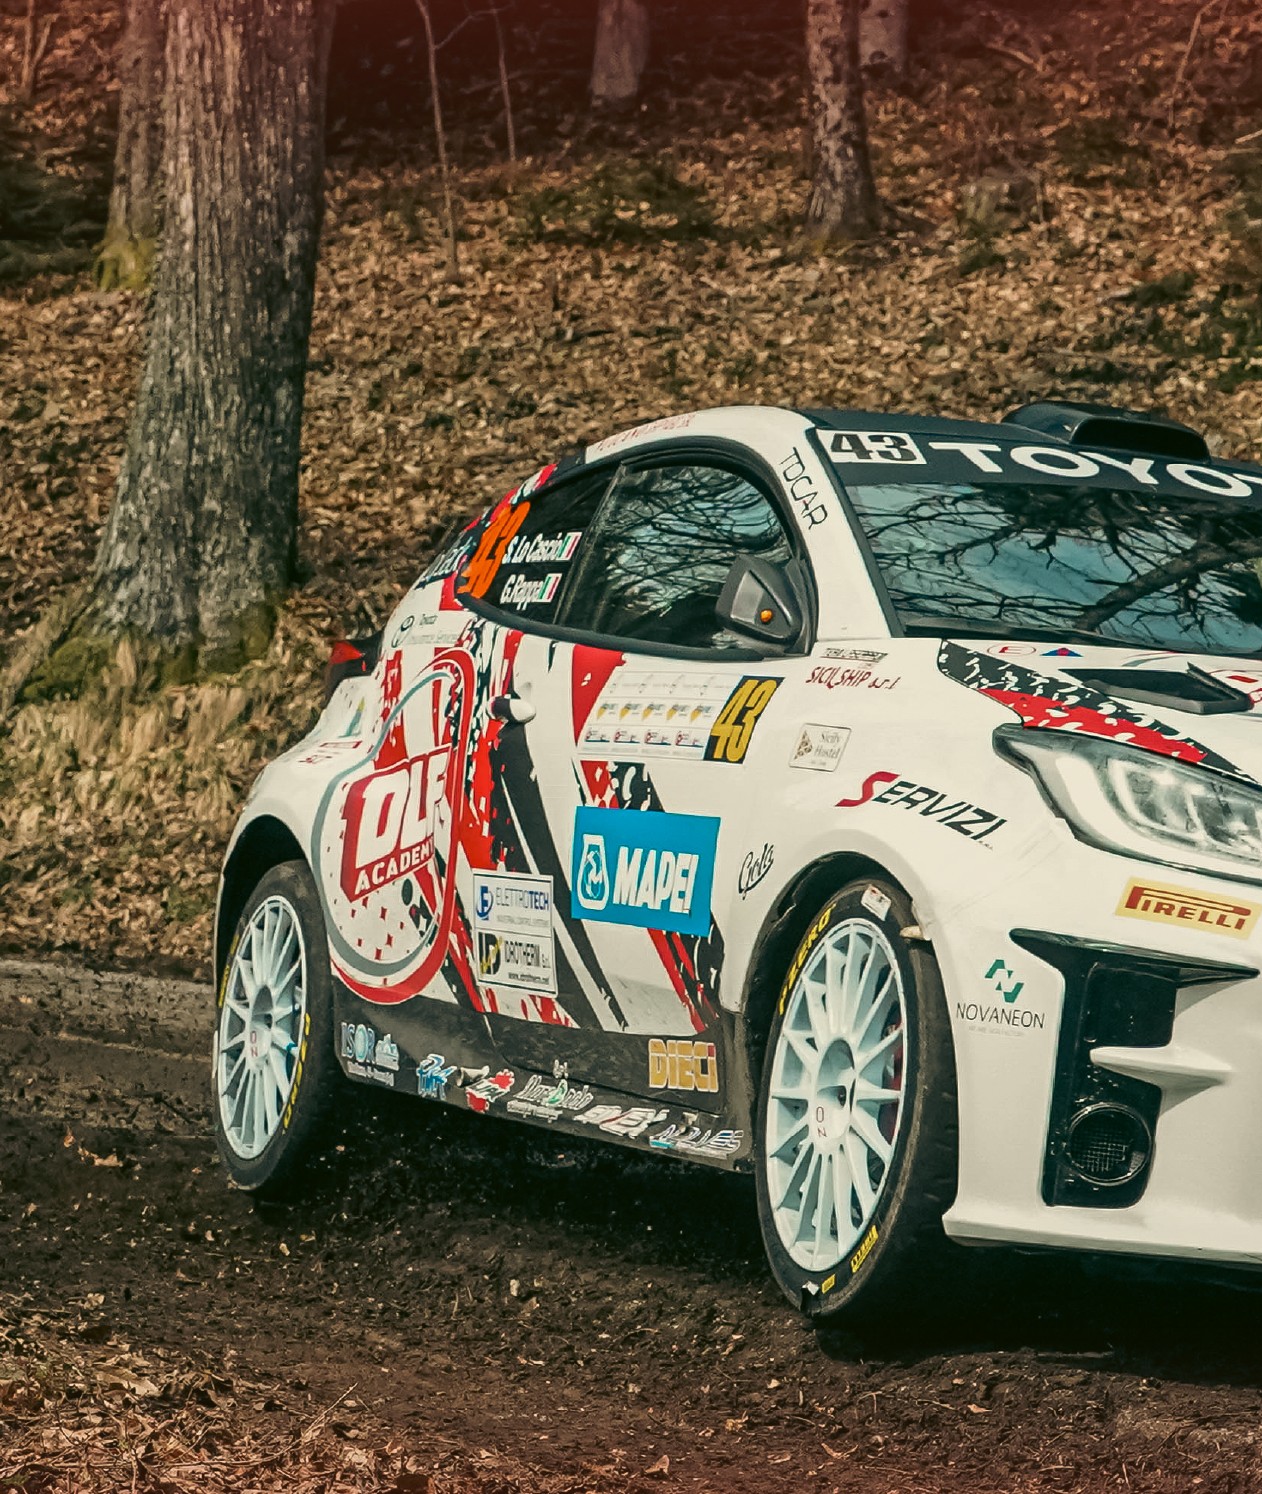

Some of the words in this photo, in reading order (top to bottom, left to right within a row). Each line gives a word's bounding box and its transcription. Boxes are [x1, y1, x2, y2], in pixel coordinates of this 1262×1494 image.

[831, 433, 917, 461] 43
[779, 447, 828, 530] TDCAR
[457, 501, 531, 599] 43
[710, 679, 777, 762] 43
[835, 771, 1007, 840] SERVIZI
[613, 846, 699, 914] MAPEI
[1125, 886, 1252, 930] PIRELLI
[956, 1002, 1046, 1029] NOVANEON
[649, 1039, 719, 1093] DIECI
